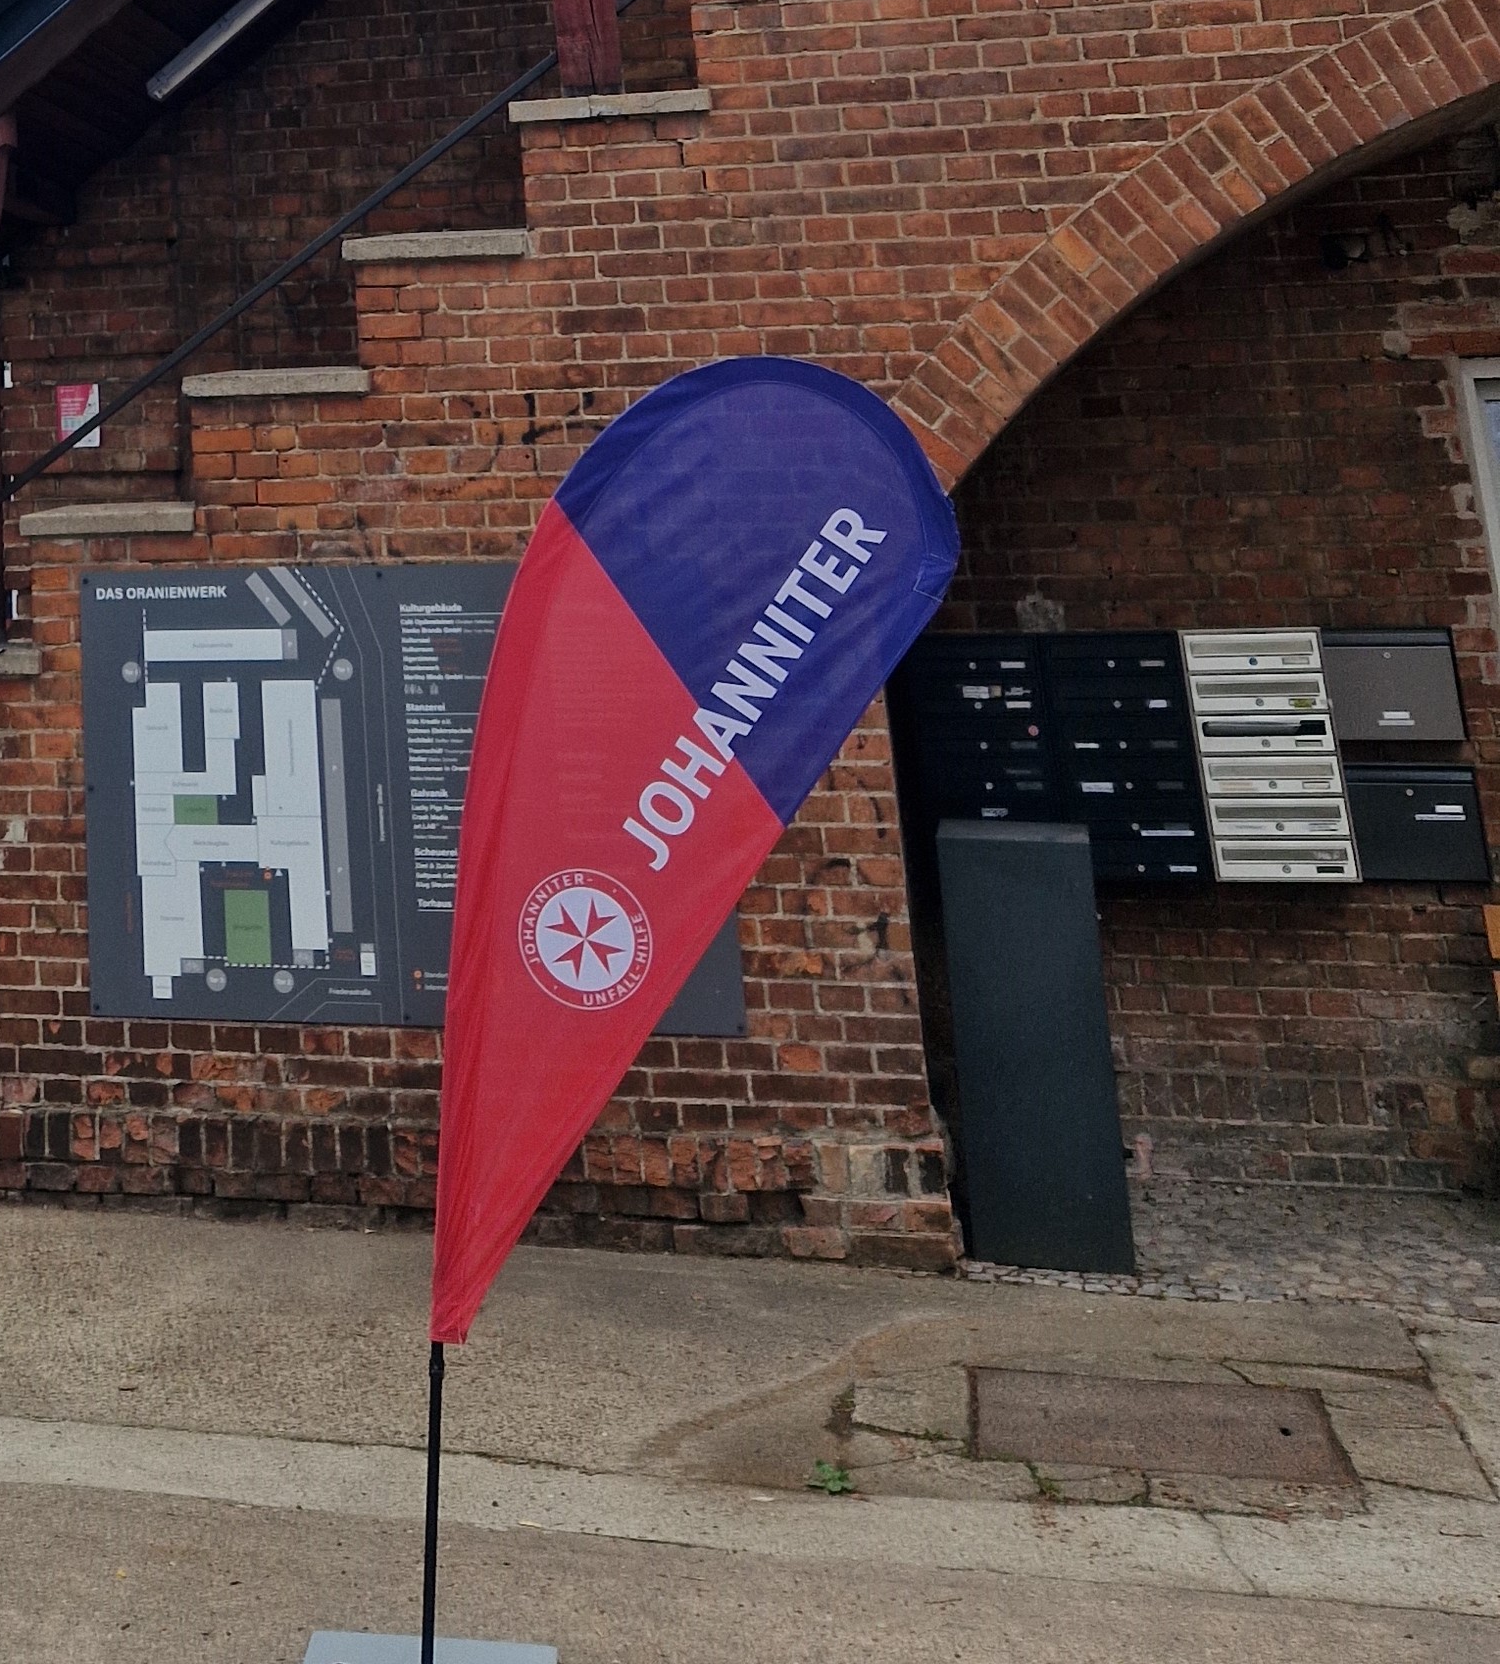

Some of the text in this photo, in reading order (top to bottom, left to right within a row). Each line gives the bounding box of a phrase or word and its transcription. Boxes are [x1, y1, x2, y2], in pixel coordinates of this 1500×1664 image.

[95, 585, 228, 601] DAS ORANIENWERK
[622, 507, 888, 872] JOHANNITER
